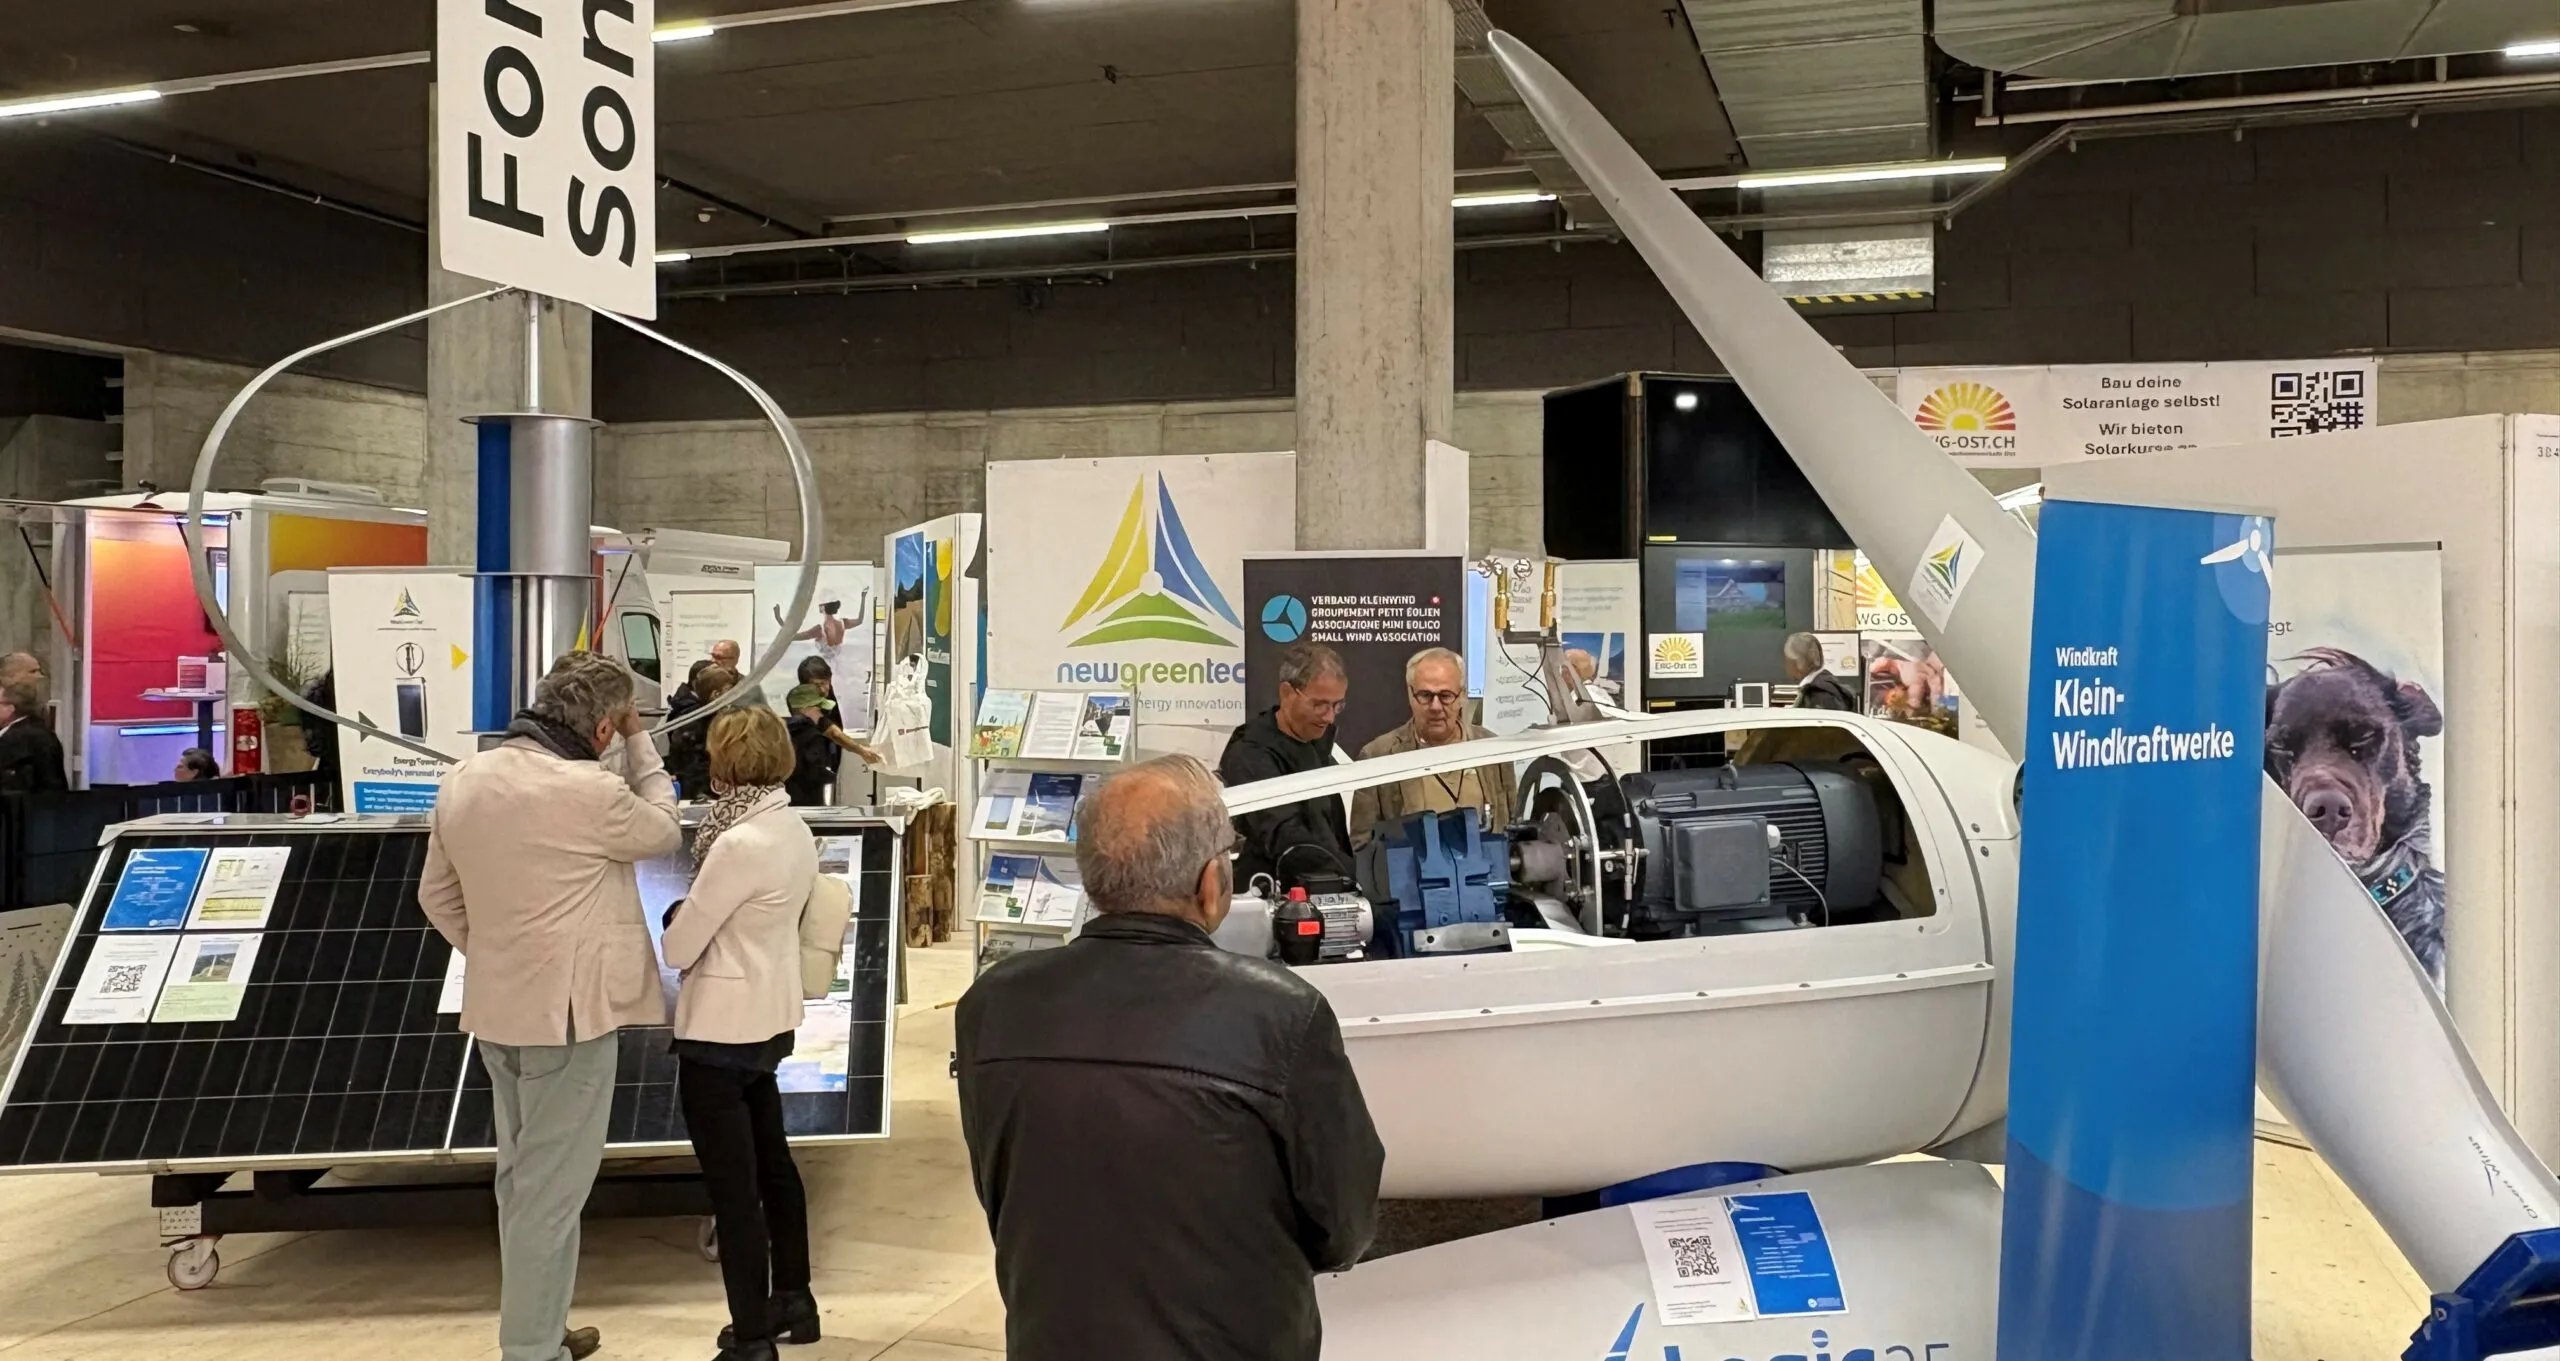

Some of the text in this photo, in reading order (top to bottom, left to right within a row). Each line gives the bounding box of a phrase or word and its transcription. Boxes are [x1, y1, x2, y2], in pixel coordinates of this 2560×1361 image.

[2101, 375, 2182, 389] Bau deine
[2062, 394, 2220, 411] Solaranlage selbst!
[2099, 422, 2183, 435] Wir bieten
[1935, 436, 2016, 449] G-OST.CH
[1311, 595, 1416, 605] VERBAND KLEINWIND
[1311, 606, 1441, 617] GROUPEMENT PETIT ÉOLIEN
[1311, 620, 1441, 630] ASSOCIAZIONE MINI EOLICO
[1311, 632, 1441, 642] SMALL WIND ASSOCIATION
[2055, 646, 2118, 667] Windkraft
[2054, 677, 2125, 718] Klein-
[2052, 722, 2235, 770] Windkraftwerke
